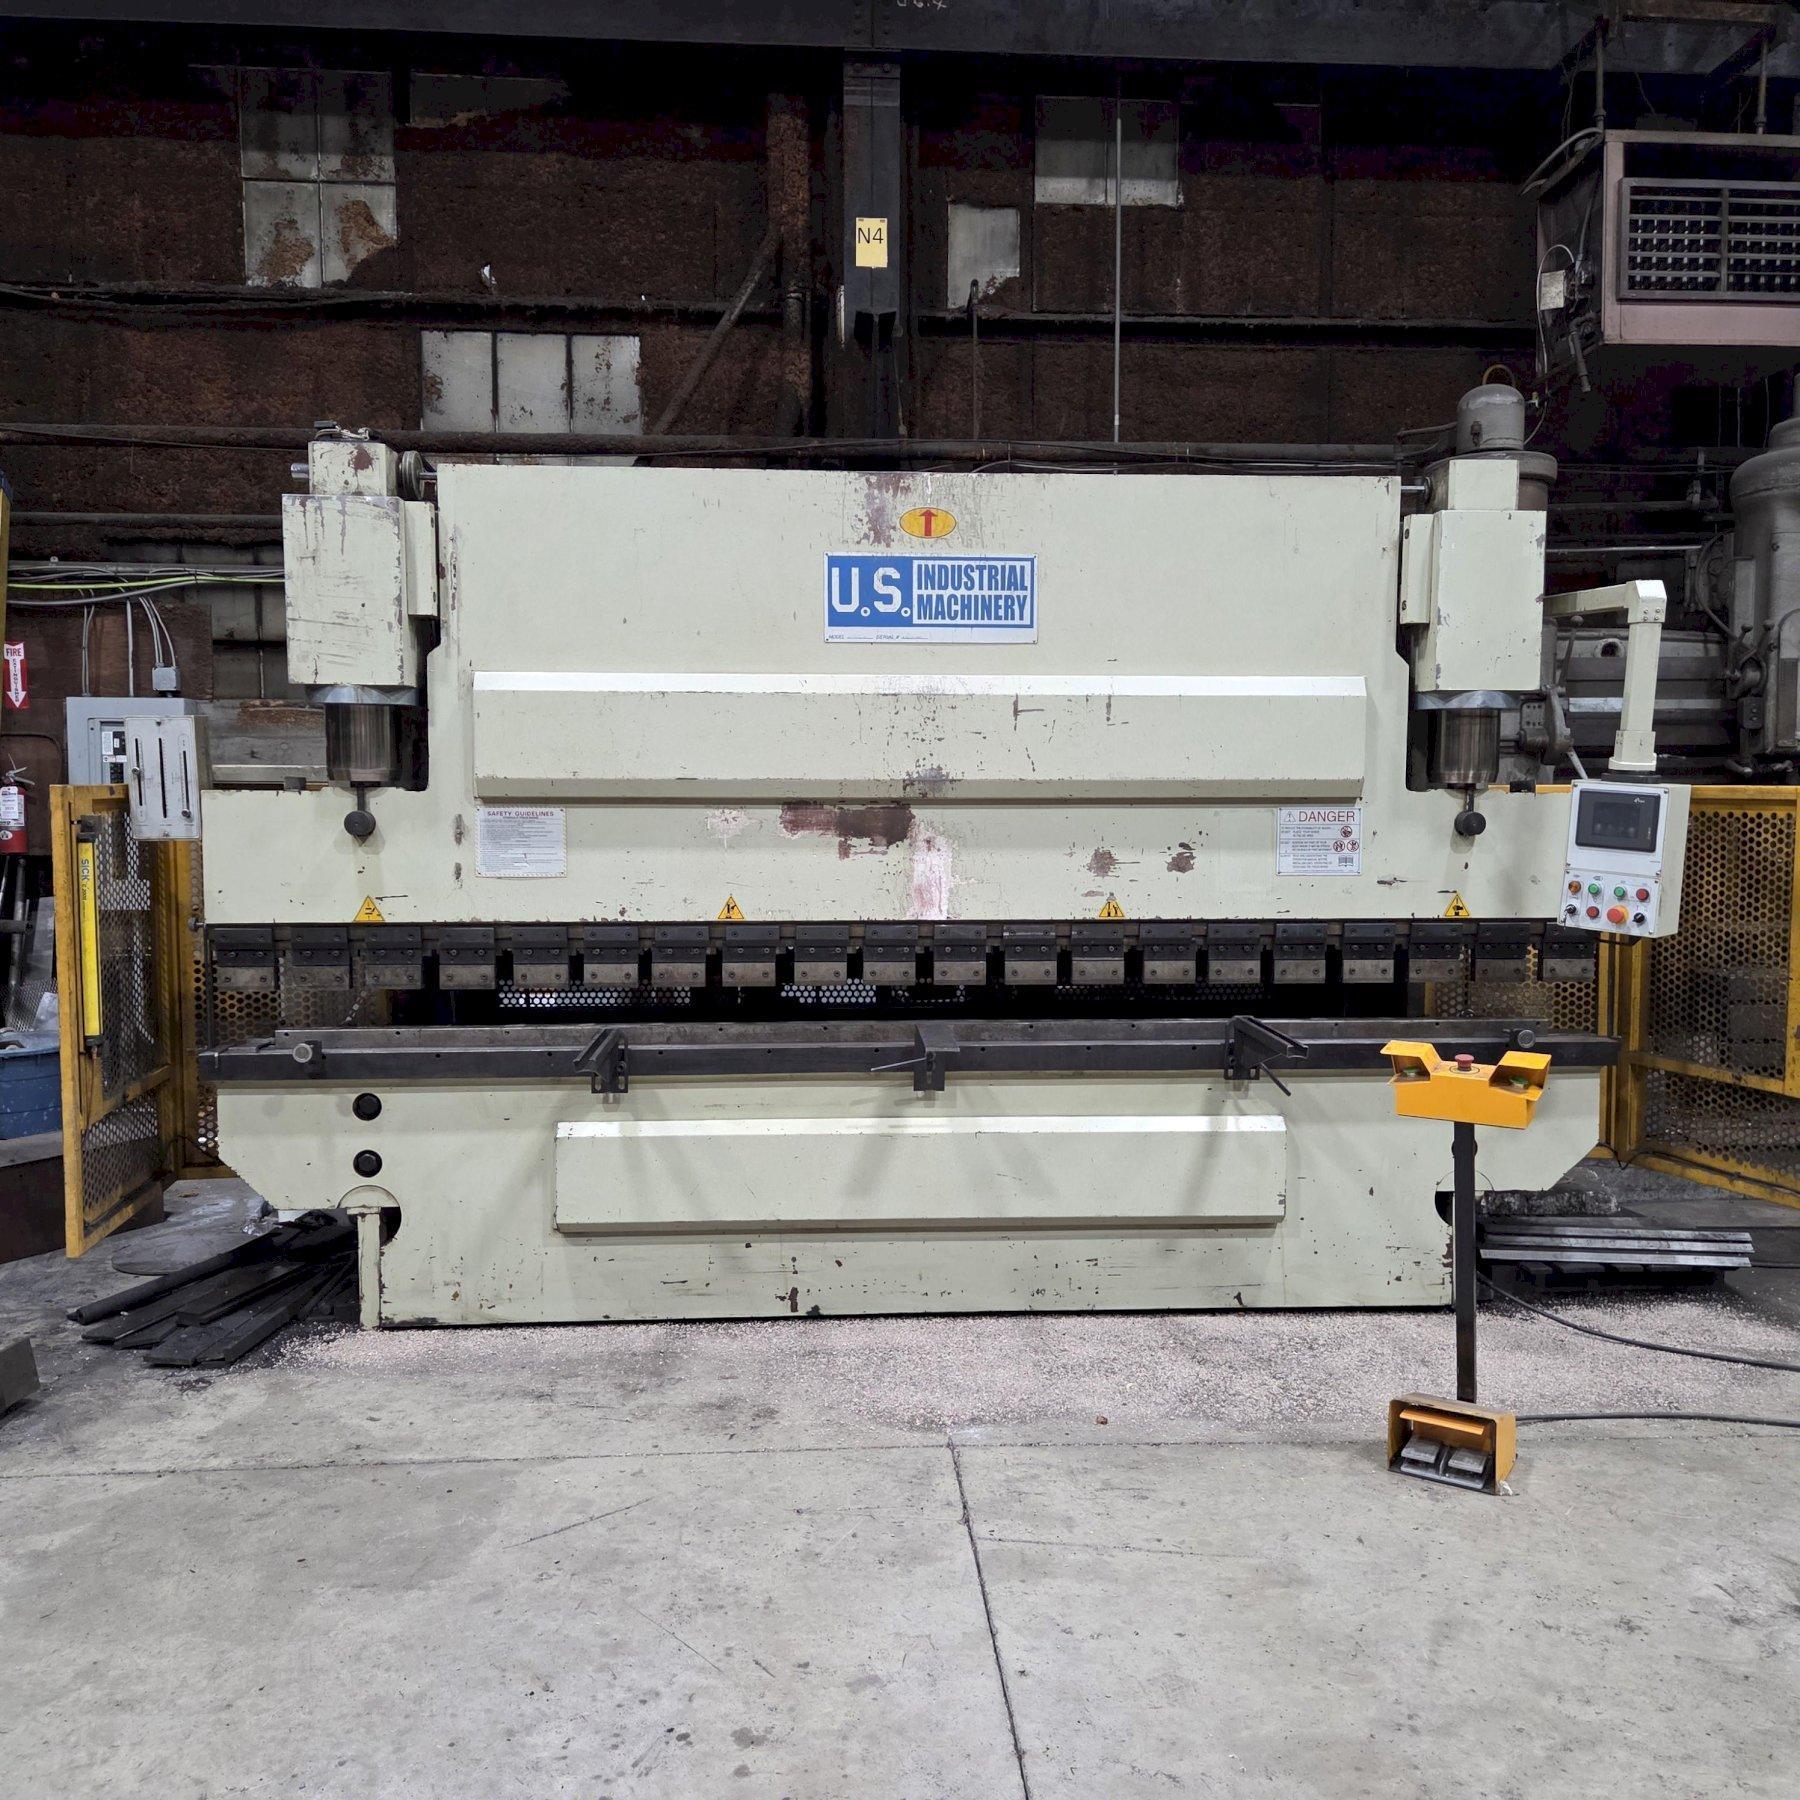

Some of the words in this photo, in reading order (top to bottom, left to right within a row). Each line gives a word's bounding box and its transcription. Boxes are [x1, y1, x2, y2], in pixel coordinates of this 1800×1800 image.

[858, 227, 884, 244] N4
[917, 563, 1028, 591] INDUSTRIAL
[831, 567, 911, 617] U.S.
[917, 593, 1028, 621] MACHINERY
[6, 647, 22, 657] FIRE
[1298, 810, 1355, 822] DANGER
[81, 858, 90, 881] SICK
